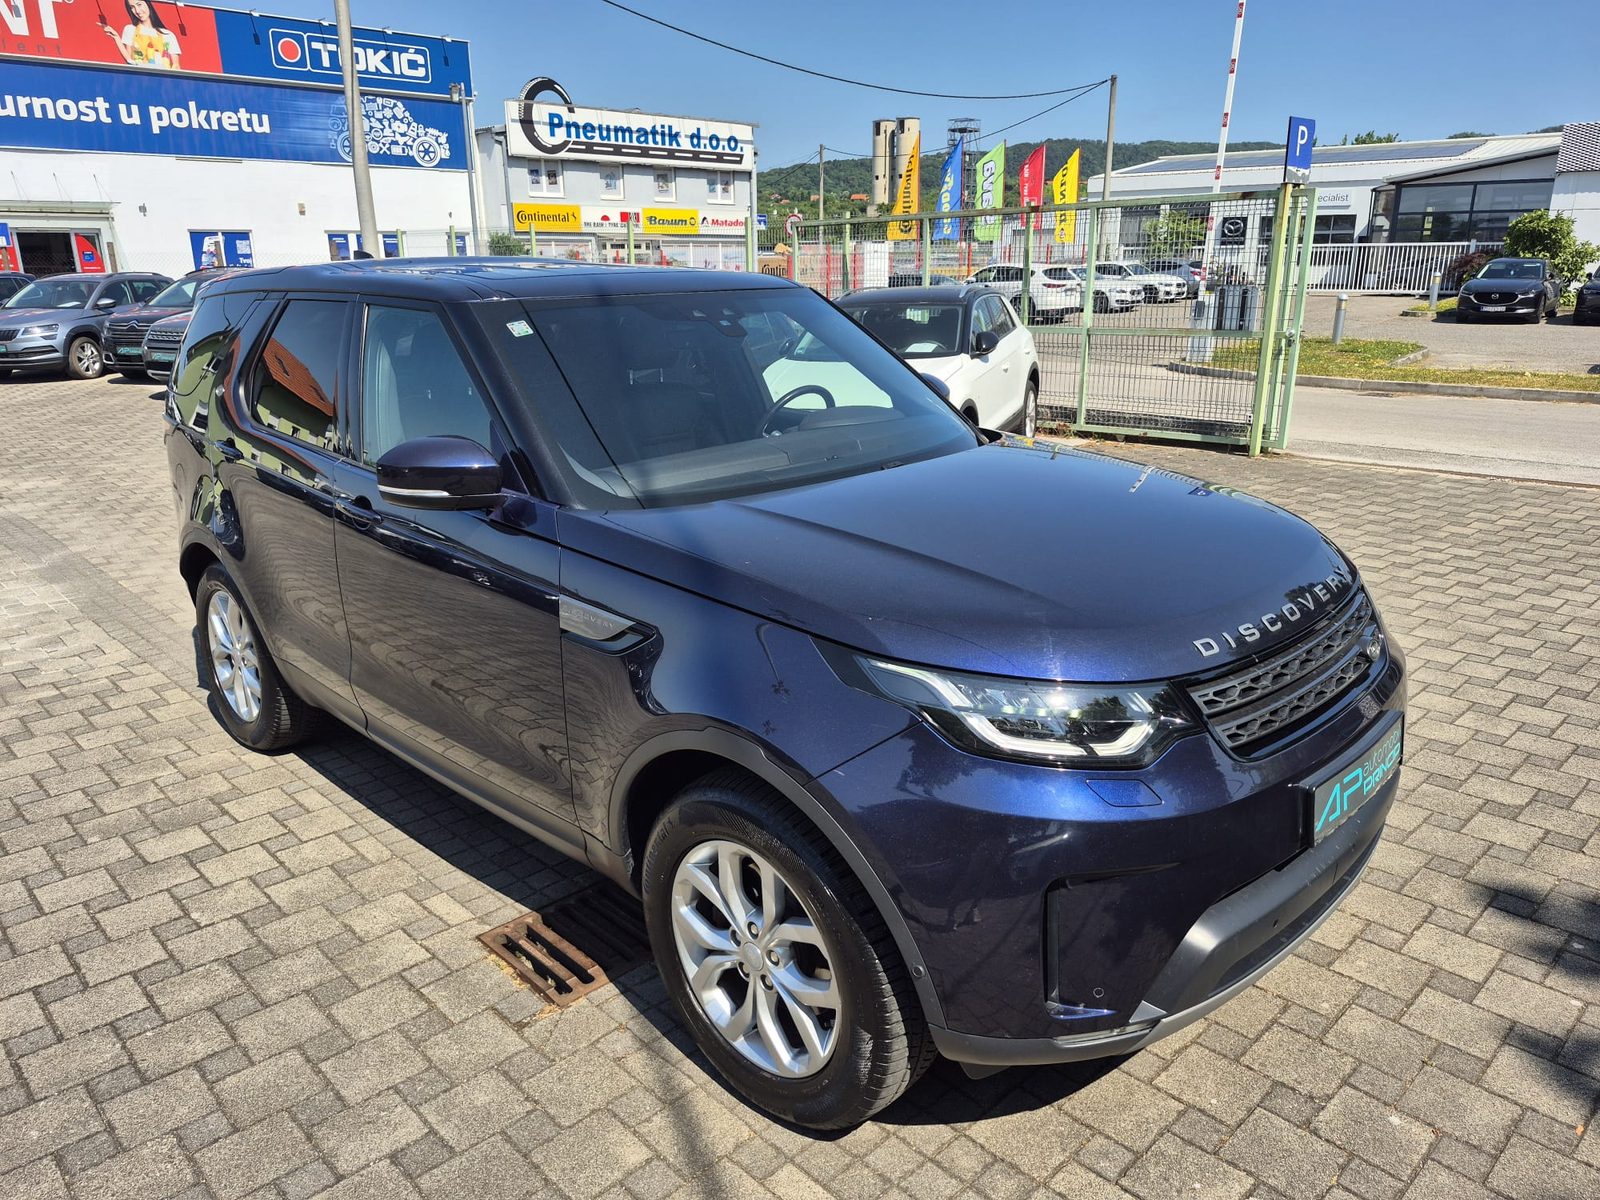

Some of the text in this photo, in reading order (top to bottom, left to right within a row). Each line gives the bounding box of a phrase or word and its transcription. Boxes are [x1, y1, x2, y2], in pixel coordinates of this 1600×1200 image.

[118, 103, 141, 125] u
[148, 101, 271, 134] pokretu
[548, 112, 744, 152] Pneumatik d.o.o.
[1296, 125, 1308, 157] P
[1318, 193, 1350, 203] ecialist
[516, 210, 570, 224] Continental
[647, 216, 688, 226] Barum
[711, 218, 746, 228] Matado
[1193, 565, 1352, 657] DISCOVERY
